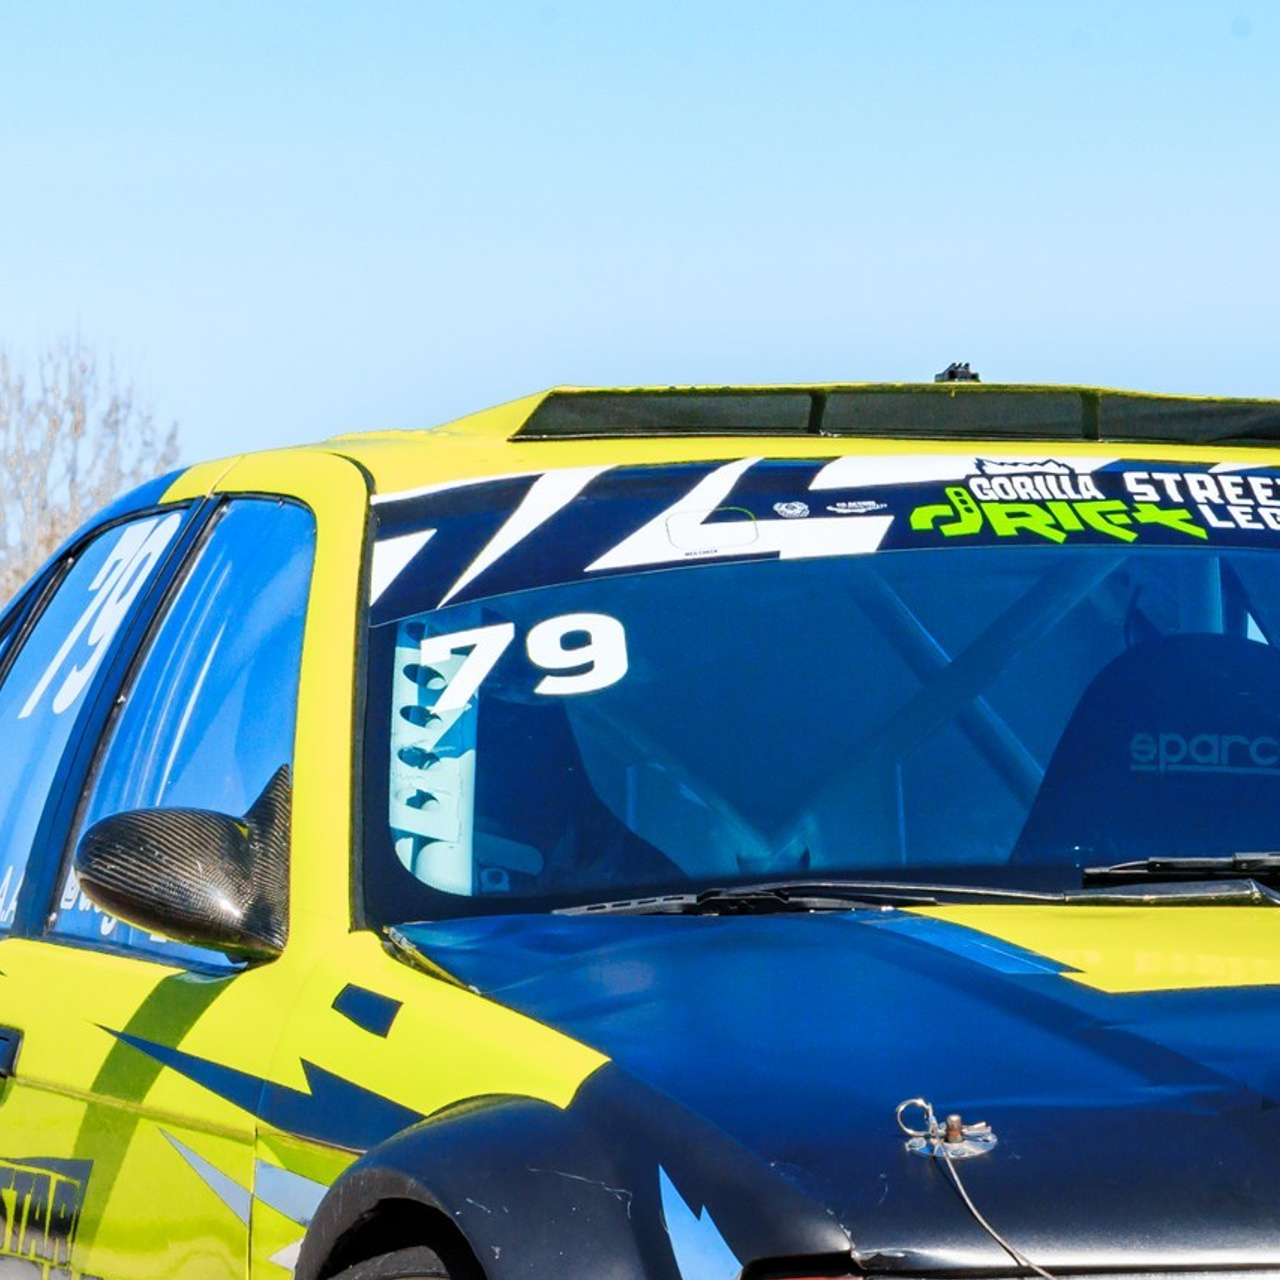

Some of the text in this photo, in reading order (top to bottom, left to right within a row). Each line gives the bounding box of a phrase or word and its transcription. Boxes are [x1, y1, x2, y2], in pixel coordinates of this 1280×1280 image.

[969, 474, 1106, 501] GORILLA
[17, 512, 182, 720] 79
[420, 612, 629, 714] 79
